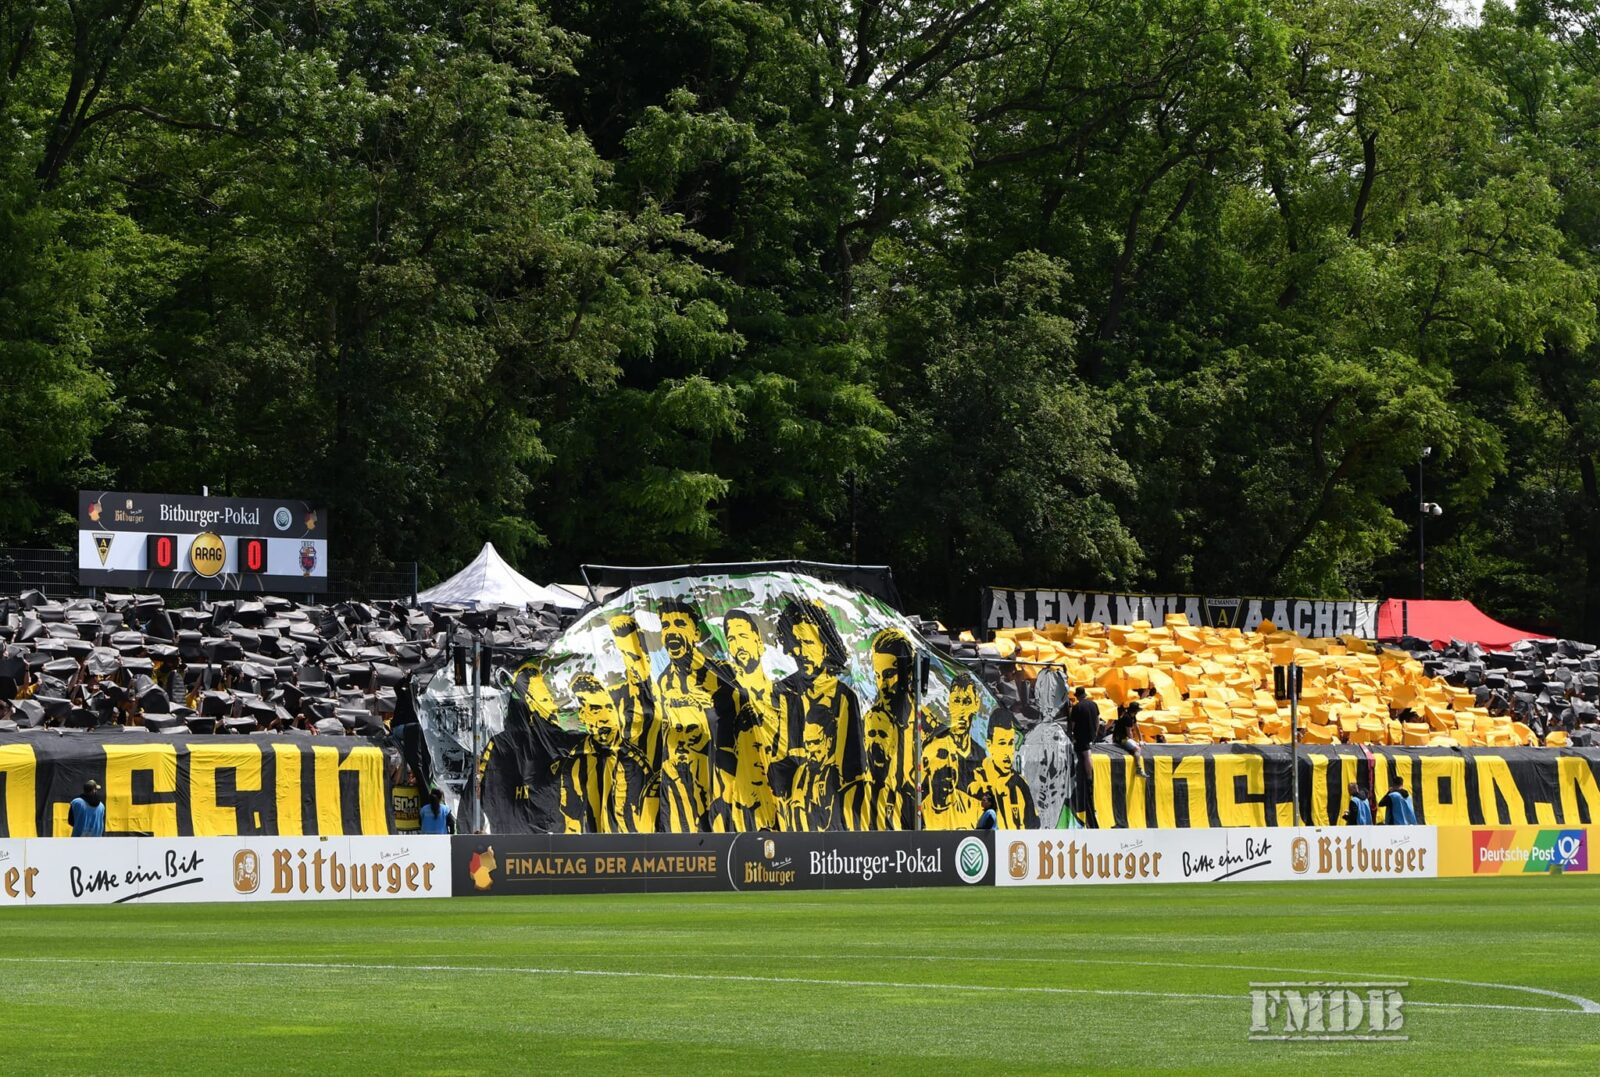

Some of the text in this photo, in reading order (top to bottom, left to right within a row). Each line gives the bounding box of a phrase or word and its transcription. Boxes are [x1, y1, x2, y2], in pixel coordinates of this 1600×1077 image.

[160, 504, 260, 527] Bitburger-Pokal
[158, 537, 171, 567] 0
[195, 547, 222, 561] ARAG
[248, 541, 261, 570] 0
[988, 590, 1377, 639] ALEMANNIA AACHEN
[1217, 608, 1229, 626] A
[505, 856, 717, 875] FINALTAG DER AMATEURE
[810, 847, 942, 880] Bitburger-Pokal
[1036, 841, 1163, 879] Bitburger
[1182, 838, 1272, 877] Bitte ein Bit
[1317, 836, 1427, 873] Bitburger
[1480, 847, 1555, 861] Deutsche Post
[70, 850, 204, 897] Bitte ein Bit
[271, 848, 436, 894] Bitburger
[744, 861, 795, 886] Bitburger
